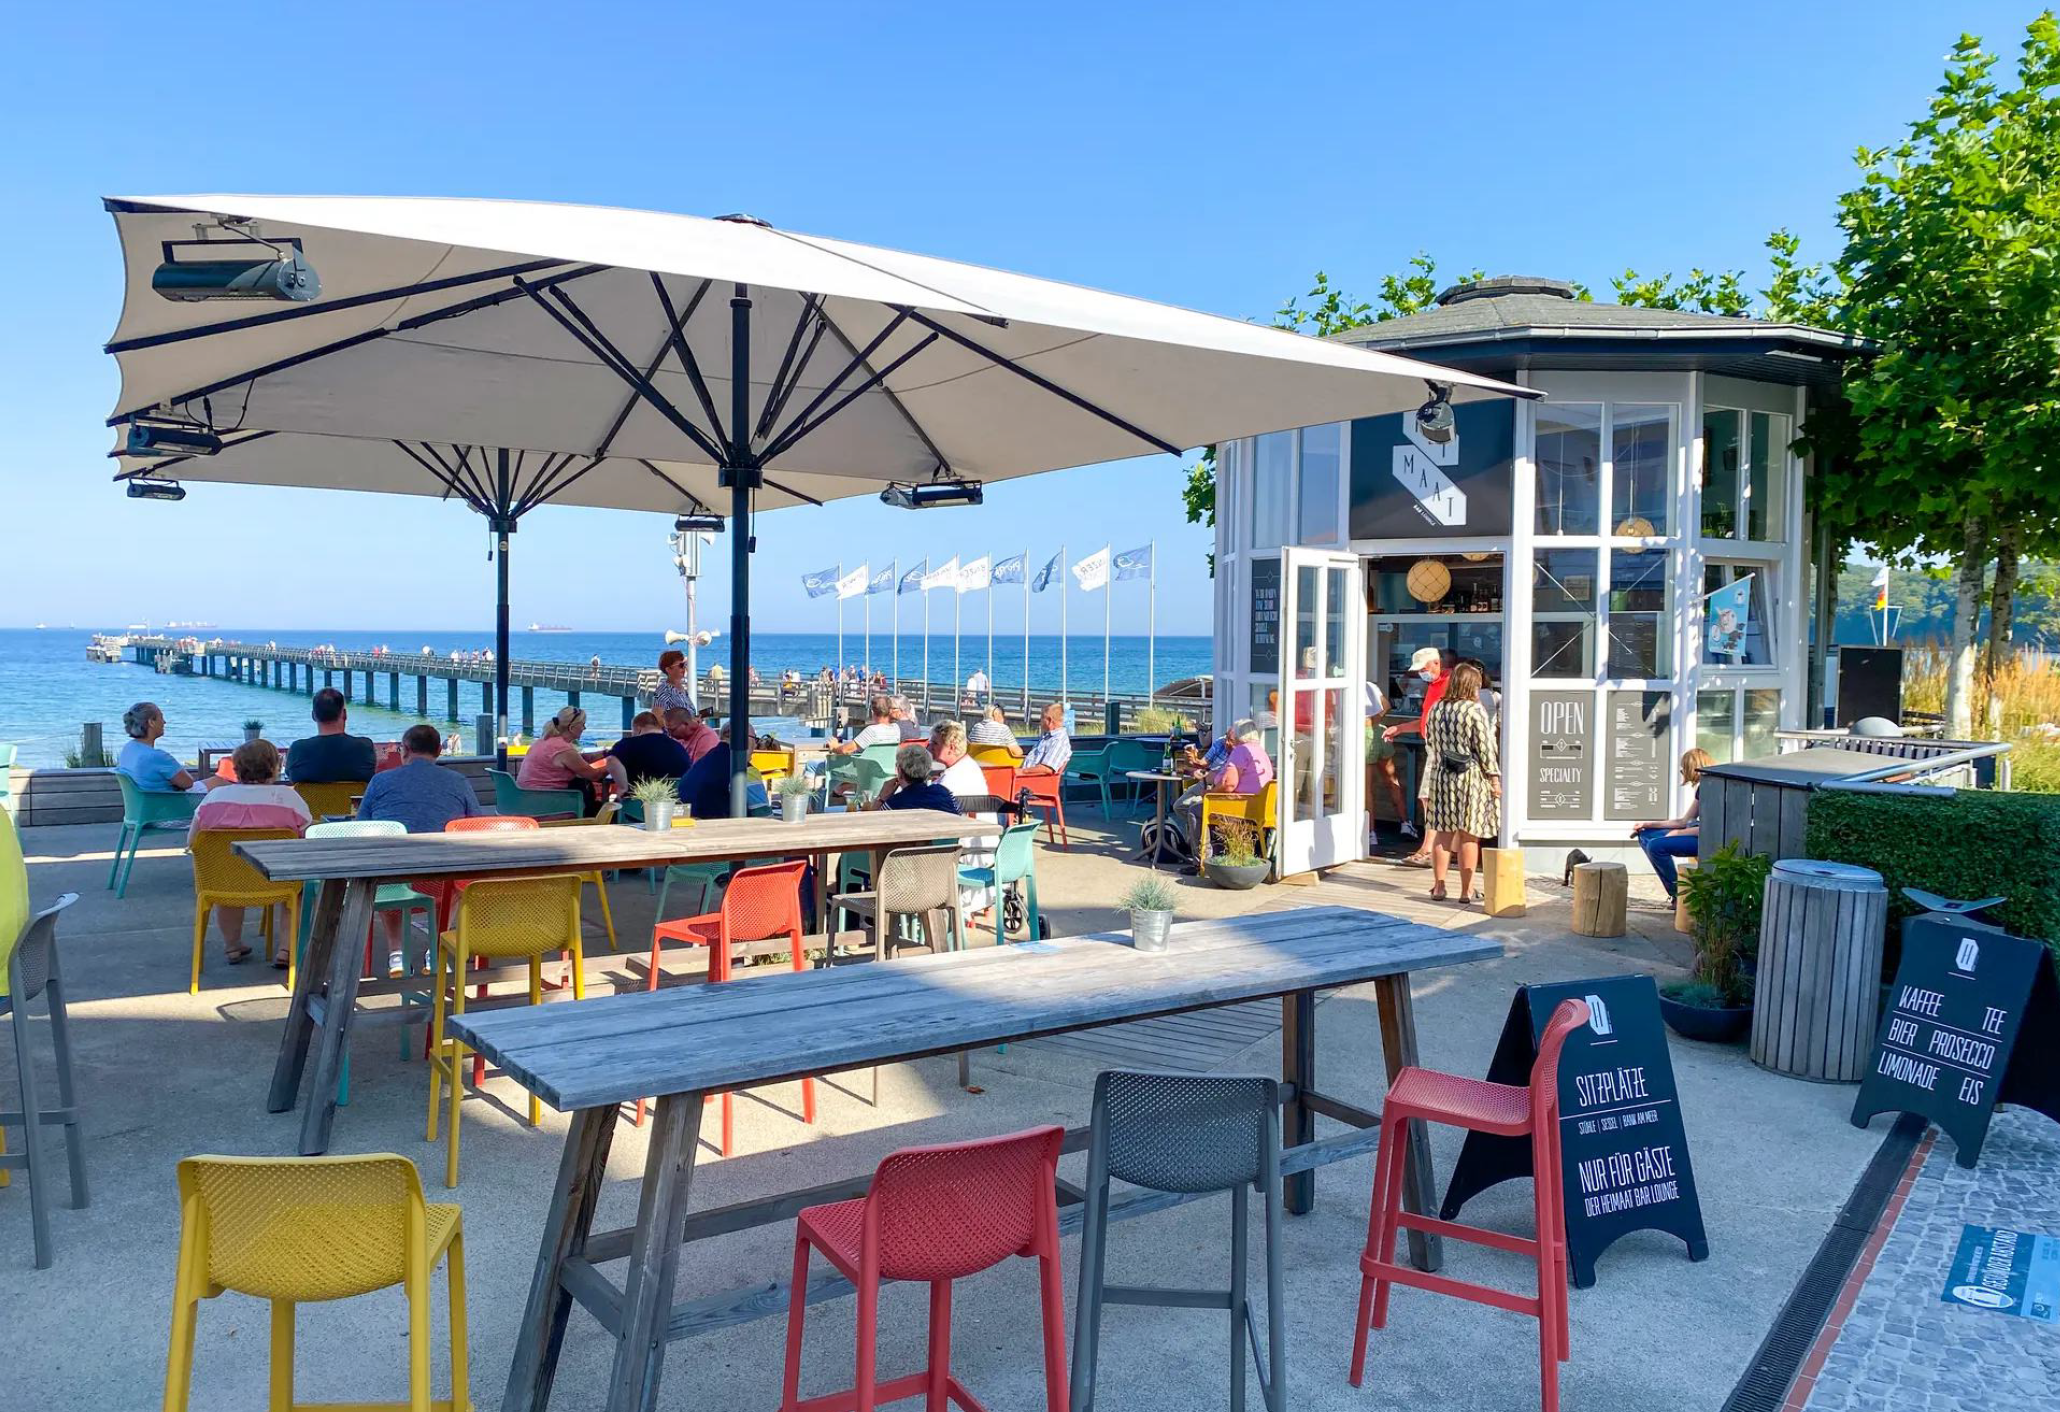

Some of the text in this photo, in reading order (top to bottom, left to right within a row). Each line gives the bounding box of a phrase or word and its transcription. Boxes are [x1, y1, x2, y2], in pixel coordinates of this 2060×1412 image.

[1403, 454, 1455, 517] MAAT
[1540, 701, 1584, 735] OPEN
[1540, 767, 1582, 783] SPECIALTY
[1898, 984, 2008, 1035] KAFFEE TEE
[1887, 1018, 1996, 1070] BIER PROSECCO
[1575, 1067, 1649, 1107] SITZPLÄTZE
[1877, 1051, 1984, 1106] LIMONADE EIS
[1578, 1109, 1659, 1136] STÜHLE SESSEL BANK AM MEER
[1578, 1145, 1676, 1193] NUR FÜR GÄSTE
[1584, 1180, 1681, 1218] DER HEIMAAT BAR LOUNGE
